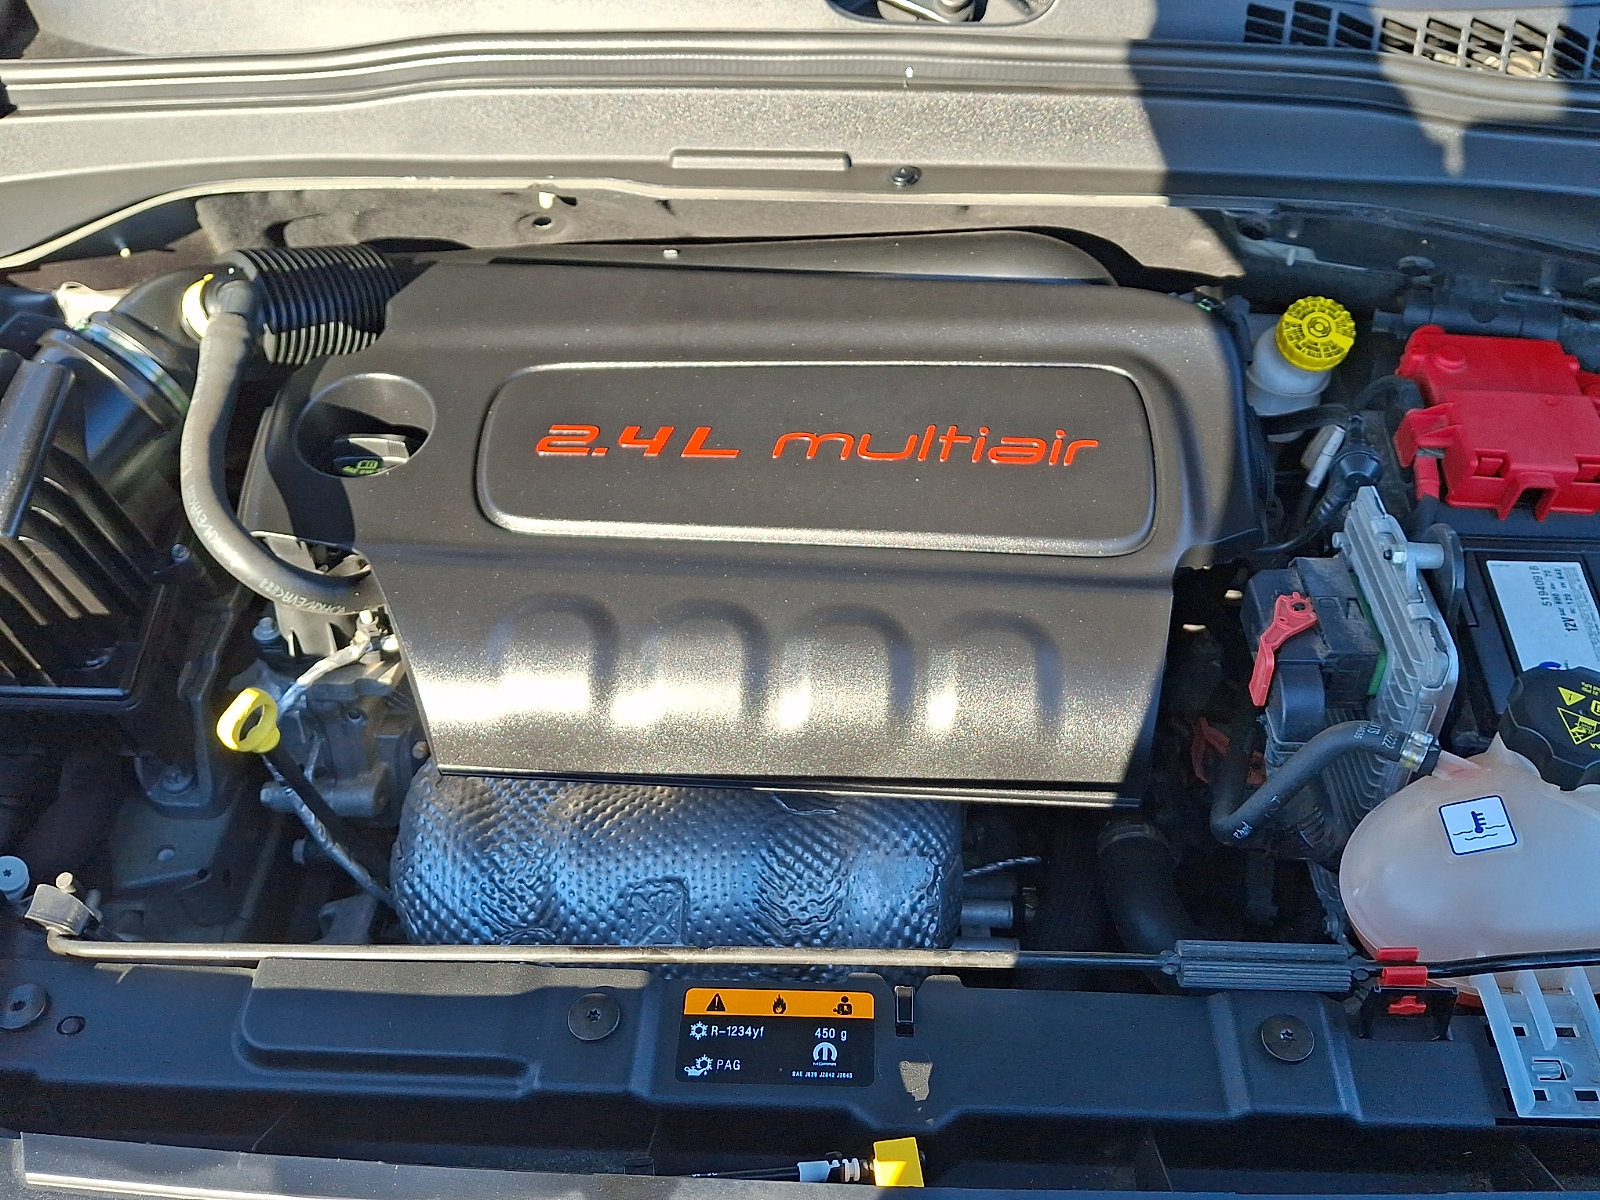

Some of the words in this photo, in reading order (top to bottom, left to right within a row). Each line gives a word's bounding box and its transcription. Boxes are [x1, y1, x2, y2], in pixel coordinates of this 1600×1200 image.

[772, 424, 1099, 467] multiair
[1561, 616, 1578, 631] 12V
[711, 1025, 764, 1038] R-1234yf
[814, 1028, 836, 1039] 450
[840, 1029, 847, 1041] g
[716, 1059, 741, 1071] PAG
